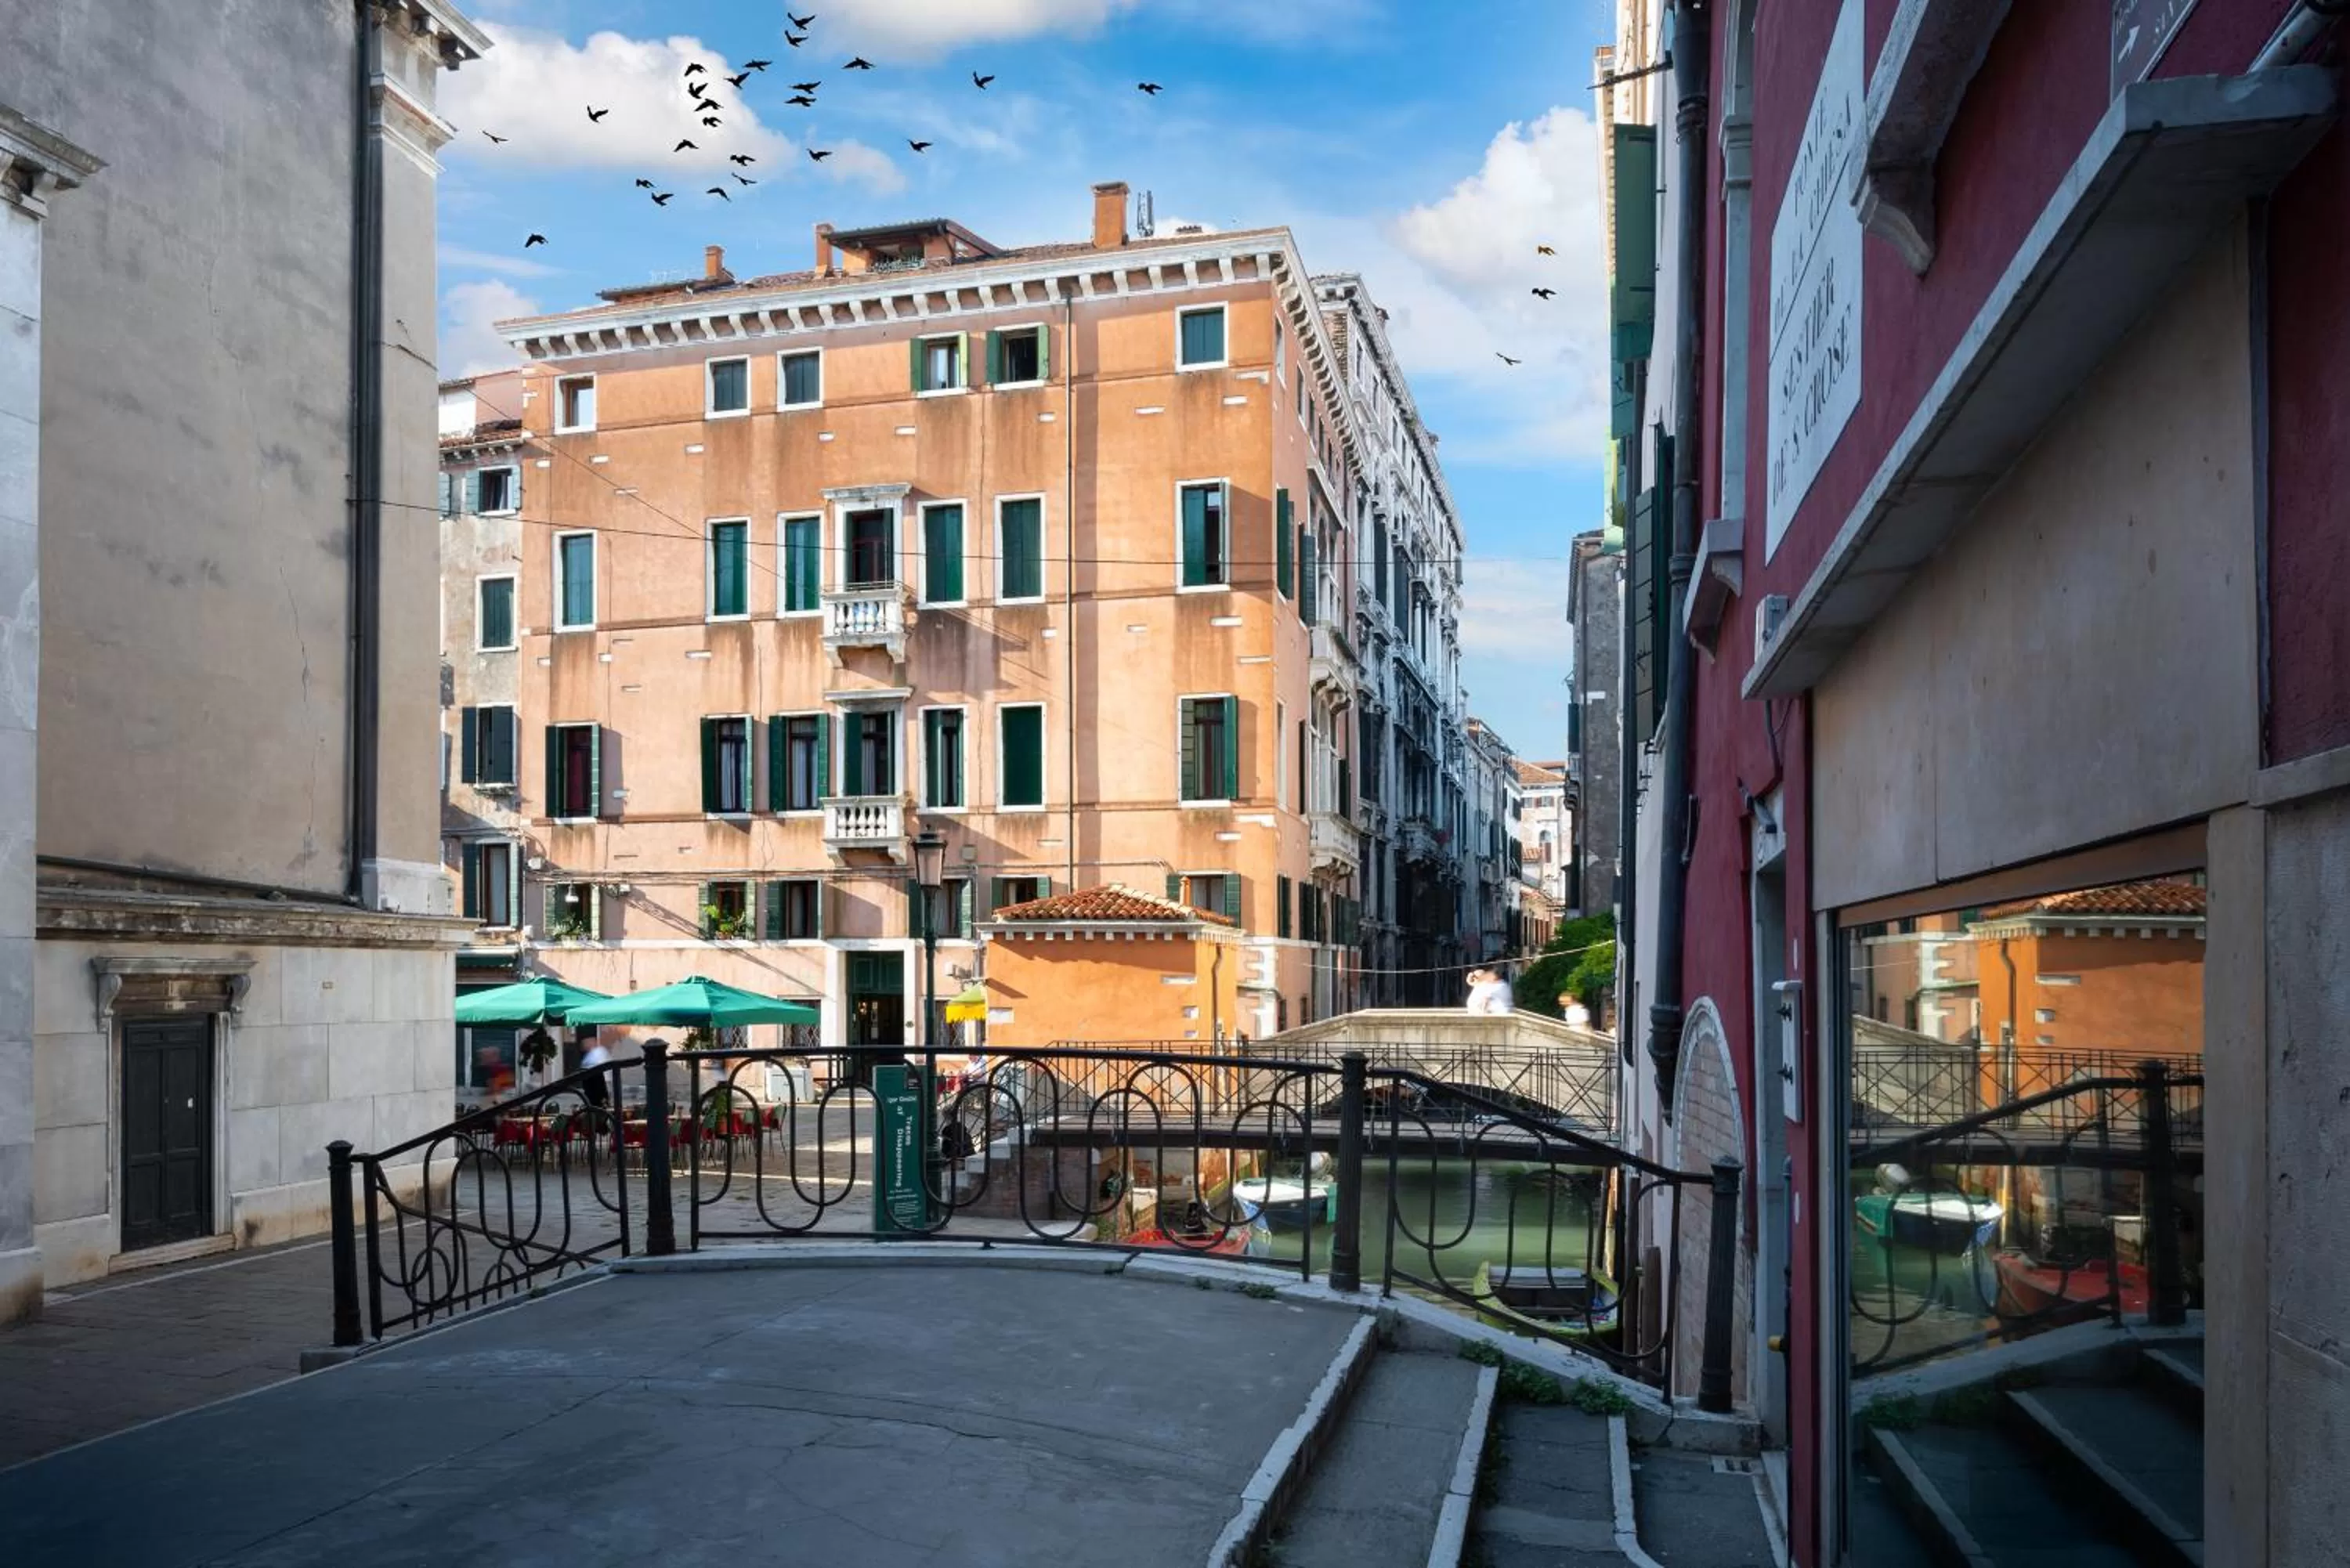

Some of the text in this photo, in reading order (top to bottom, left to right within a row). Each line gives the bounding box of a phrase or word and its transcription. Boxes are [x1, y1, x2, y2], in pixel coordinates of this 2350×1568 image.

[1772, 438, 1789, 508] DE
[1803, 300, 1852, 438] CROSE
[1782, 256, 1835, 416] SESTIER
